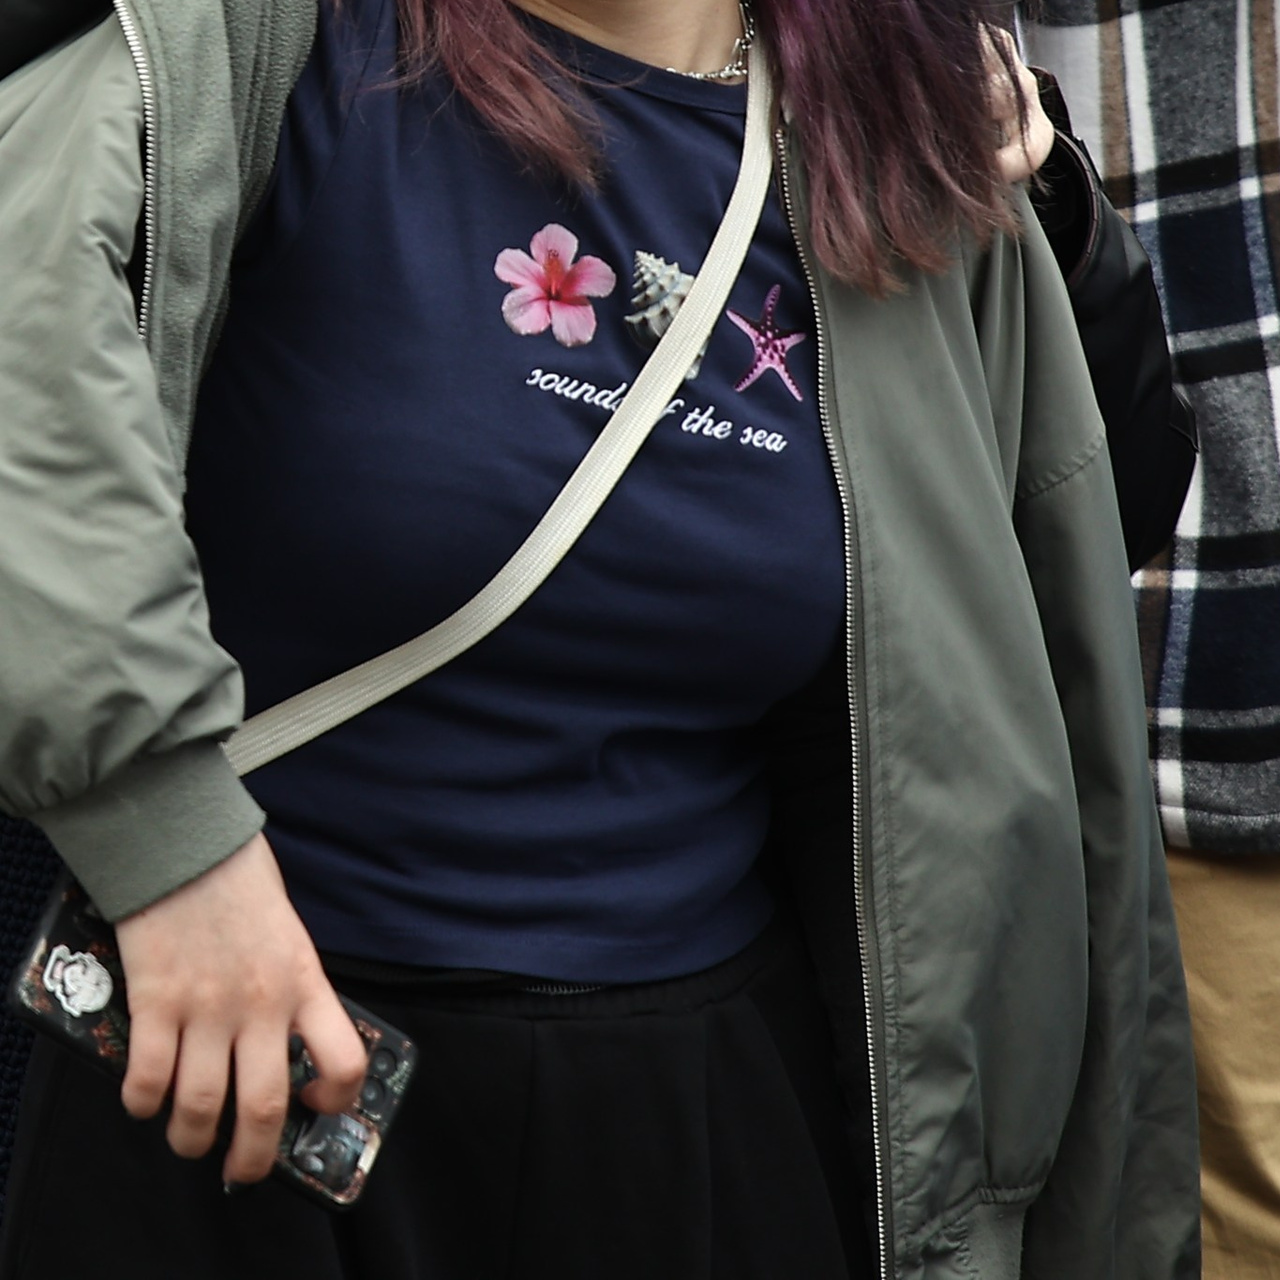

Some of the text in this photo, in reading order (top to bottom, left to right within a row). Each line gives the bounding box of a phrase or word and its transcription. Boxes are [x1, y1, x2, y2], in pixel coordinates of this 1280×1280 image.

[658, 398, 685, 421] f
[681, 405, 733, 439] the
[740, 426, 788, 453] sea
